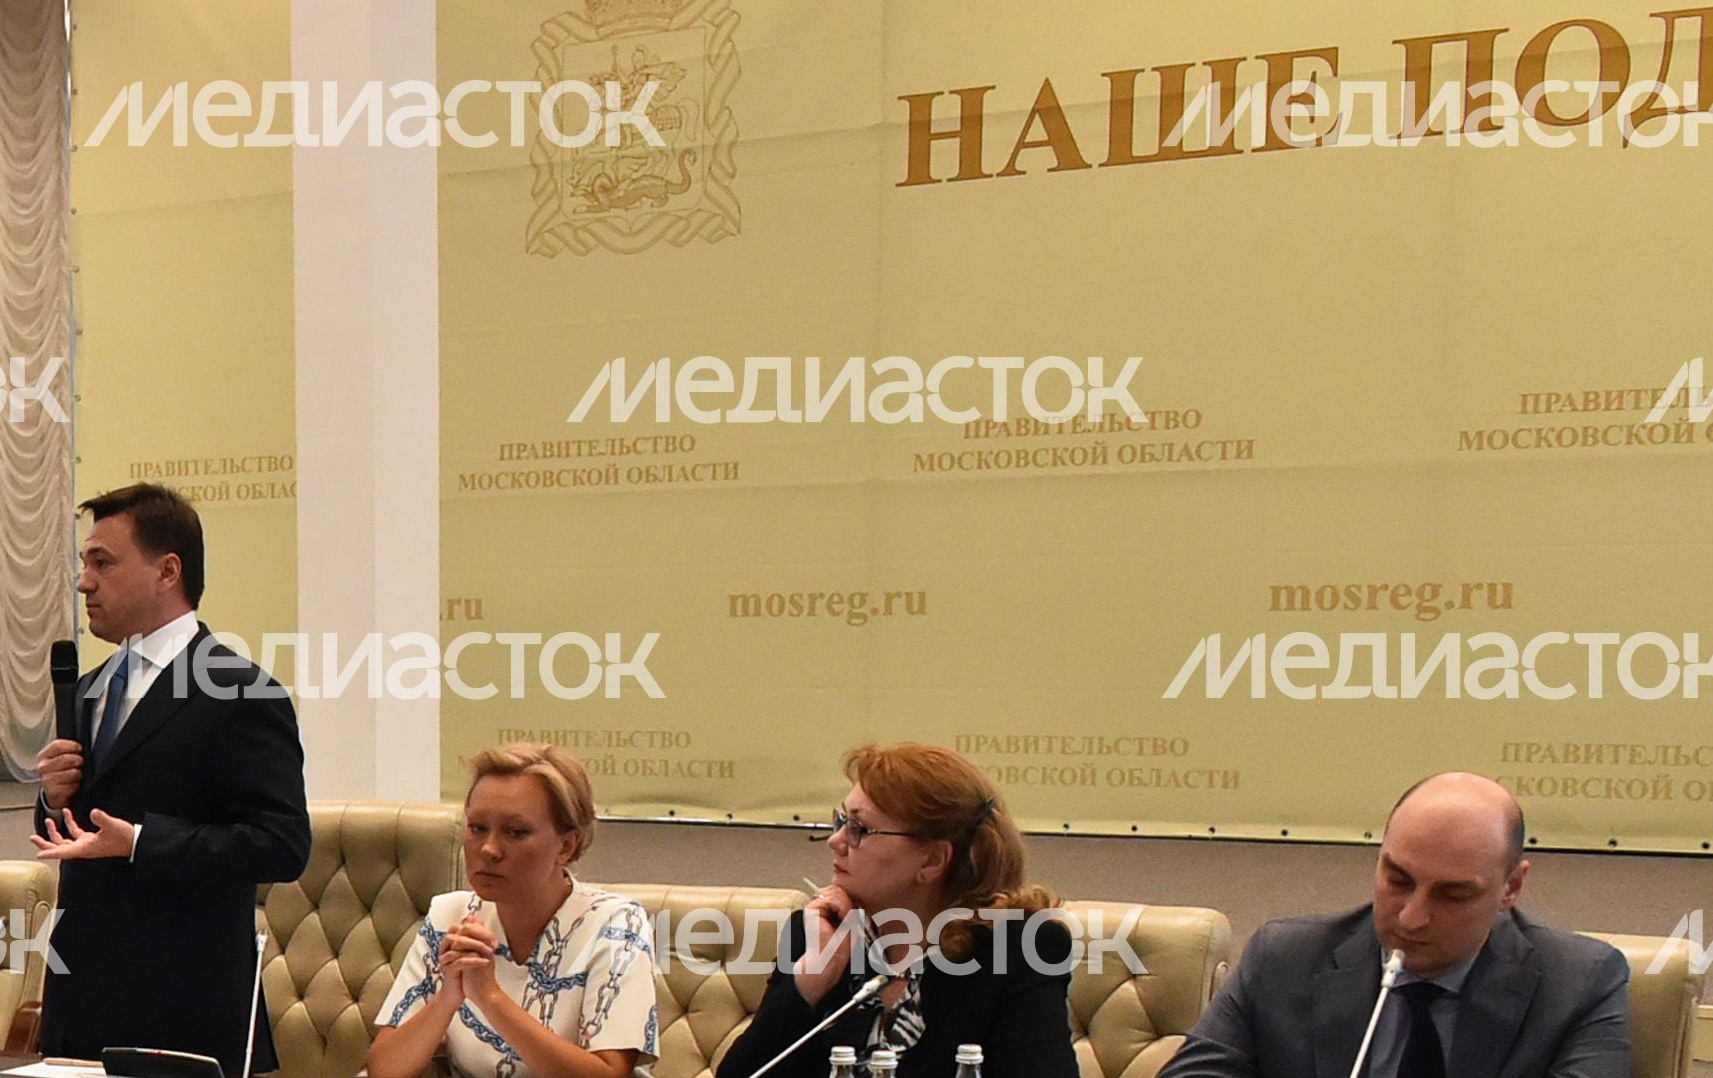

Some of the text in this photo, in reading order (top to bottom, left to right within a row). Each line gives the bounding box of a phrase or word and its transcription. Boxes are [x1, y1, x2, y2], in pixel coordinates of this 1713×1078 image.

[894, 44, 1342, 190] НАШЕ
[964, 408, 1203, 439] ПРАВИТЕЛЬСТВО
[1458, 416, 1695, 450] МОСКОВСКОЙ
[499, 434, 696, 461] ПРАВИТЕЛЬСТВО
[913, 438, 1256, 472] МОСКОВСКОЙ ОБЛАСТИ
[130, 455, 294, 479] ПРАВИТЕЛЬСТВО
[458, 462, 740, 491] МОСКОВСКОЙ ОБЛАСТИ
[727, 590, 928, 627] mosreg.ru
[1268, 581, 1514, 622] mosreg.ru
[955, 734, 1190, 757] ПРАВИТЕЛЬСТВО
[623, 758, 736, 779] ОБЛАСТИ
[1106, 767, 1242, 790] ОБЛАСТИ
